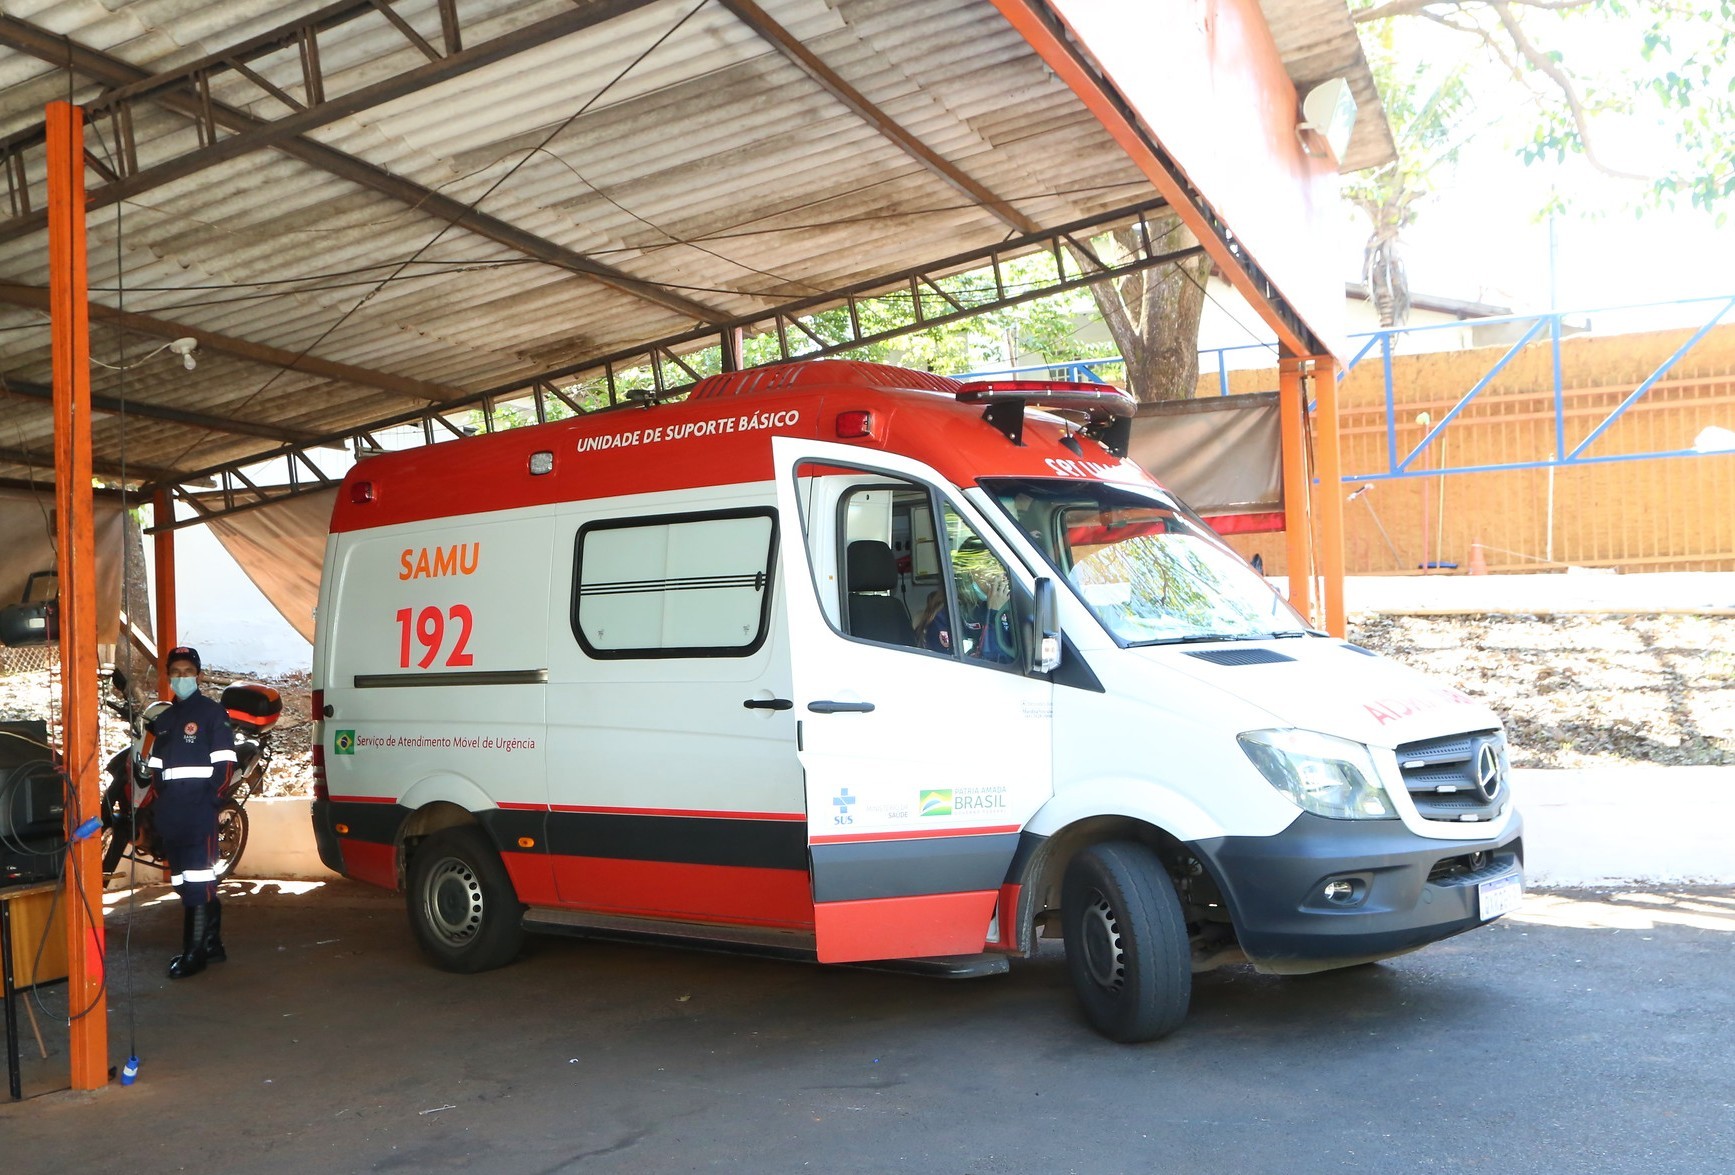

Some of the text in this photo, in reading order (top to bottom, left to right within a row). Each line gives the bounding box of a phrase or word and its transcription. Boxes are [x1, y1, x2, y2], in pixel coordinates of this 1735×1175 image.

[577, 409, 799, 452] UNIDADE DE SUPORTE BÁSICO
[399, 542, 480, 581] SAMU
[396, 604, 474, 669] 192
[356, 735, 536, 753] Serviço de Atendimento Móvel de Urgência
[954, 795, 1006, 810] BRASIL
[833, 815, 854, 826] SUS
